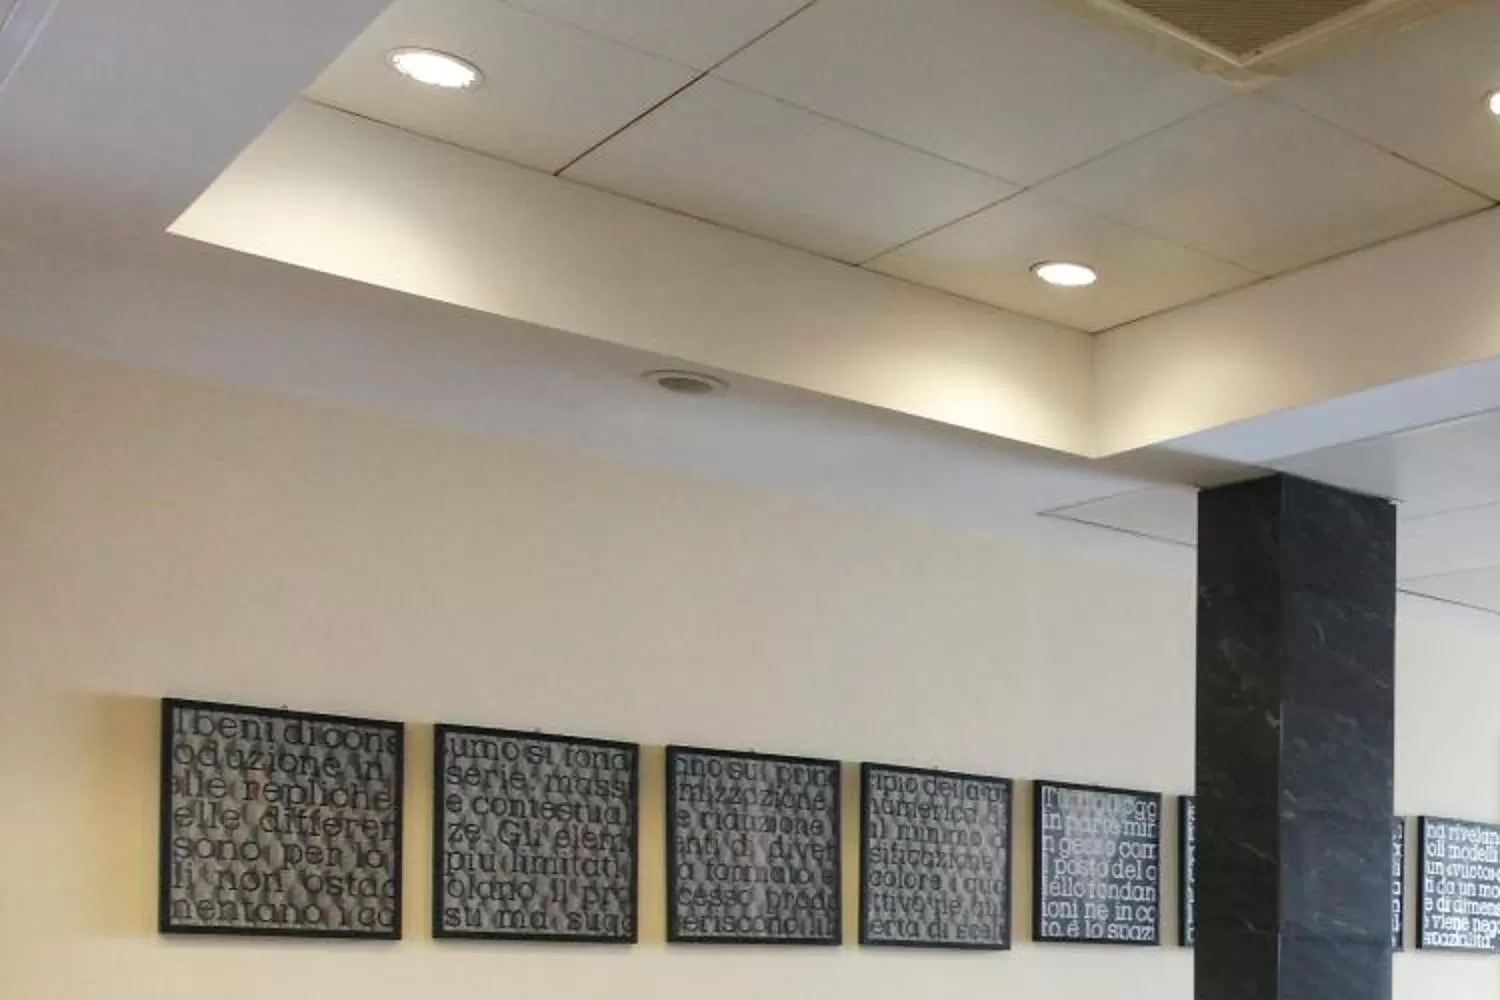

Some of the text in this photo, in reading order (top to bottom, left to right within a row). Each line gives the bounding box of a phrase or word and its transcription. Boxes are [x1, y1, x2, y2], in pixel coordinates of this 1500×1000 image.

[192, 709, 273, 742] beni
[176, 738, 345, 779] oduzione
[449, 738, 520, 761] umo
[242, 778, 391, 811] repliche
[447, 794, 463, 813] e
[174, 801, 240, 830] elle
[677, 809, 691, 828] e
[174, 837, 384, 870] sono per lo
[216, 868, 284, 892] non
[1111, 858, 1142, 881] del
[1114, 902, 1133, 922] in
[1085, 919, 1103, 939] lo
